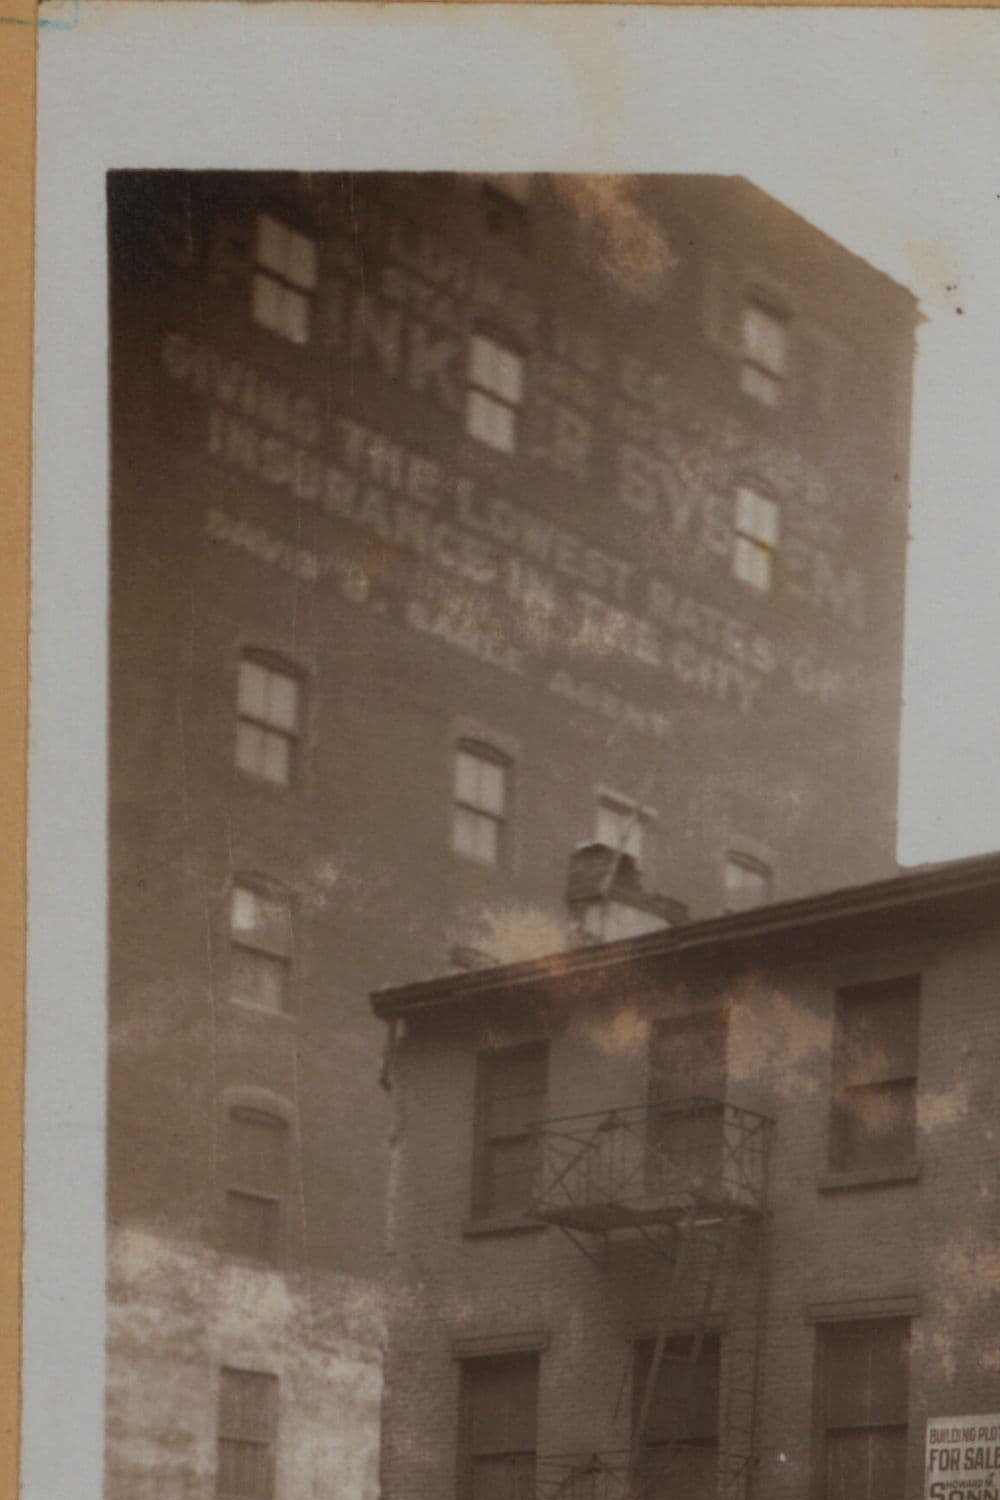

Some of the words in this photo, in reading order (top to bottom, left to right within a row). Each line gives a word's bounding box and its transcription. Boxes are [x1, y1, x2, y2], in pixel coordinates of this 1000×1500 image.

[206, 405, 498, 593] INSURANCE
[671, 636, 760, 721] CITY
[336, 412, 439, 511] THE
[456, 475, 635, 609] LOWEST
[647, 572, 776, 679] RATES
[929, 1427, 976, 1444] BUILDING
[930, 1449, 960, 1472] FOR
